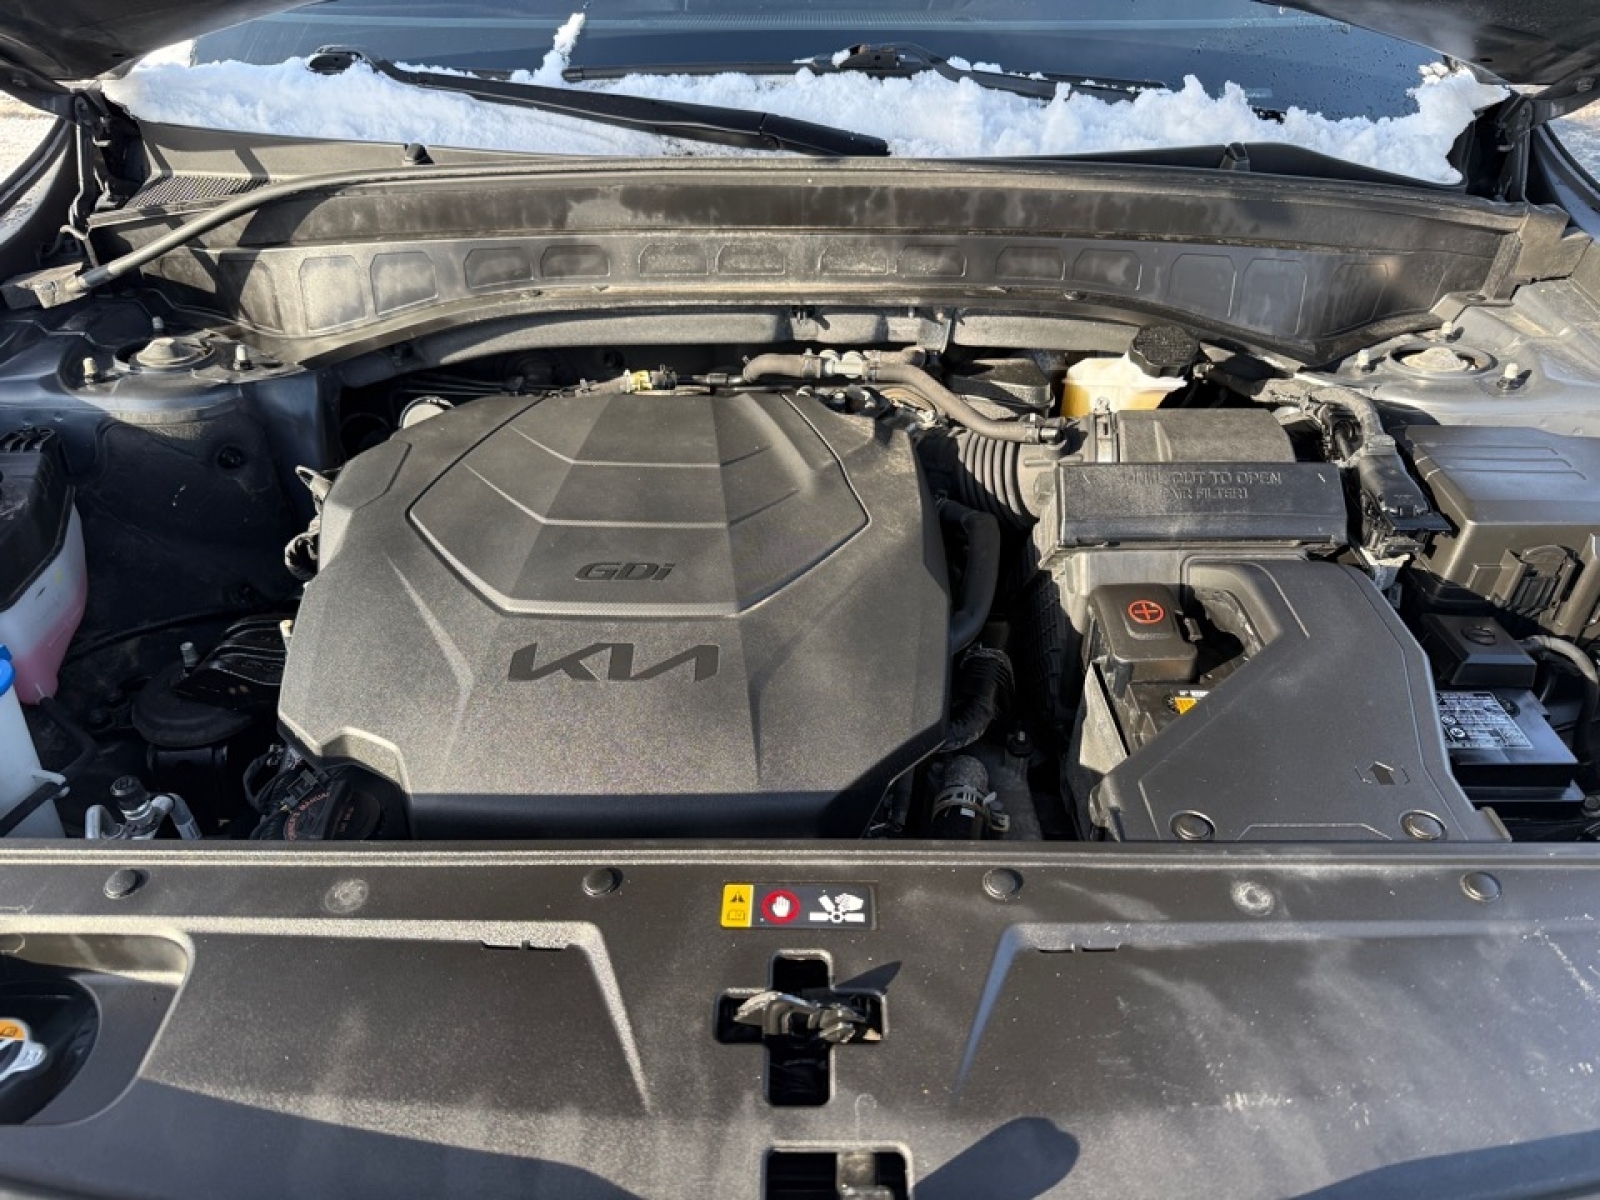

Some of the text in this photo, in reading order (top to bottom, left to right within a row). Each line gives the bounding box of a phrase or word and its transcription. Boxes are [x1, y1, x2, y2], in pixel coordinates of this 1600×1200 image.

[1209, 470, 1232, 485] TO
[1236, 471, 1282, 485] OPEN
[575, 562, 676, 581] GDi
[508, 642, 720, 683] KIA
